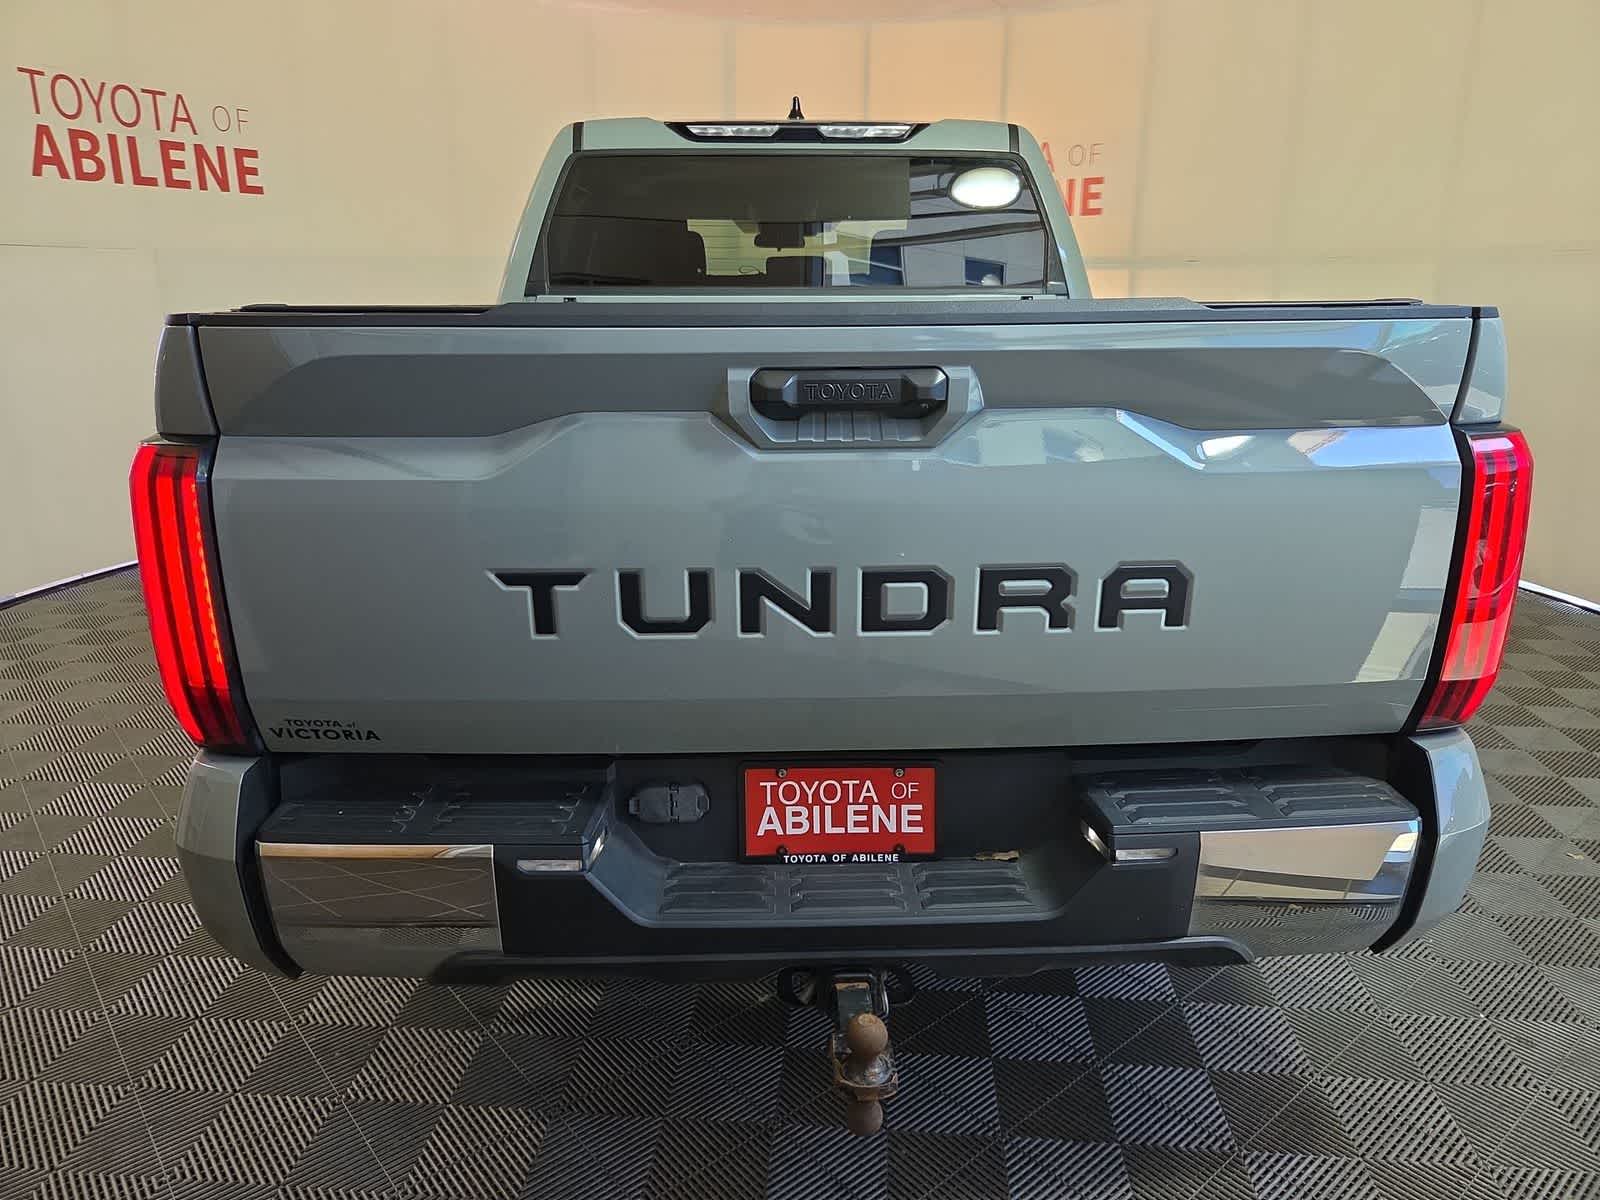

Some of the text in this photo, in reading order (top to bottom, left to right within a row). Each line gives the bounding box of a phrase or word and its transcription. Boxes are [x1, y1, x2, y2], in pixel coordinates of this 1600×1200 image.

[17, 66, 249, 135] TOYOTA OF
[32, 123, 264, 195] ABILENE
[1068, 143, 1104, 167] OF
[803, 382, 895, 401] TOYOTA
[485, 558, 1196, 641] TUNDRA
[269, 727, 382, 741] VICTORIA
[285, 719, 342, 728] TOYOTA
[760, 780, 919, 805] TOYOTA OF
[756, 804, 924, 836] ABILENE
[783, 853, 900, 864] TOYOTA OF ABILENE
